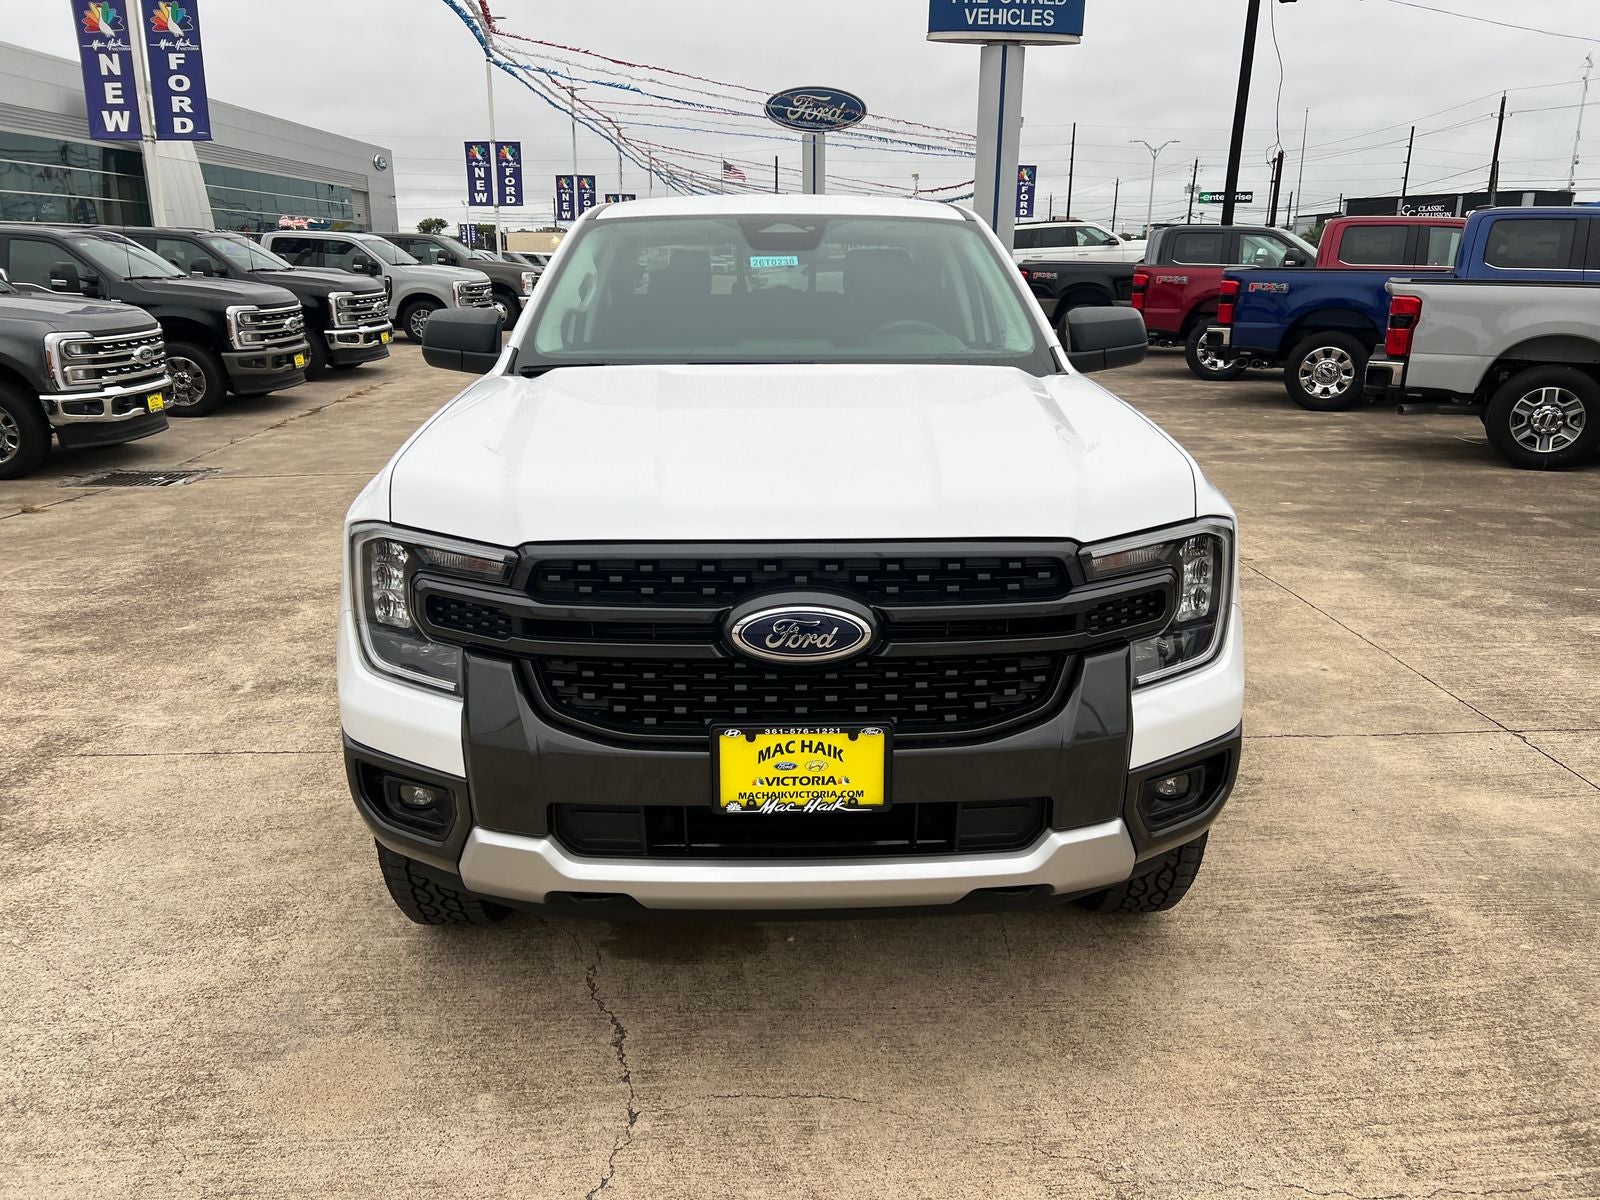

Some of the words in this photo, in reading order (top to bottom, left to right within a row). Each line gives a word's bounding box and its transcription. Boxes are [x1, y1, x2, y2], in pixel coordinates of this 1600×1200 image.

[965, 8, 1055, 27] VEHICLES
[98, 54, 130, 132] NEW
[168, 53, 194, 134] FORD
[787, 95, 846, 121] Ford
[474, 168, 487, 203] NEW
[505, 168, 516, 204] FORD
[1203, 193, 1252, 201] enterise
[561, 193, 571, 219] NEW
[583, 193, 592, 210] FO
[1020, 186, 1029, 216] FORD
[765, 618, 839, 649] Ford
[757, 740, 796, 764] MAC
[800, 740, 844, 763] HAIK
[765, 776, 838, 787] VICTORIA
[738, 790, 865, 800] MACHAIKVICTORIA.COM
[759, 798, 800, 814] Mac
[803, 797, 850, 814] Haik
